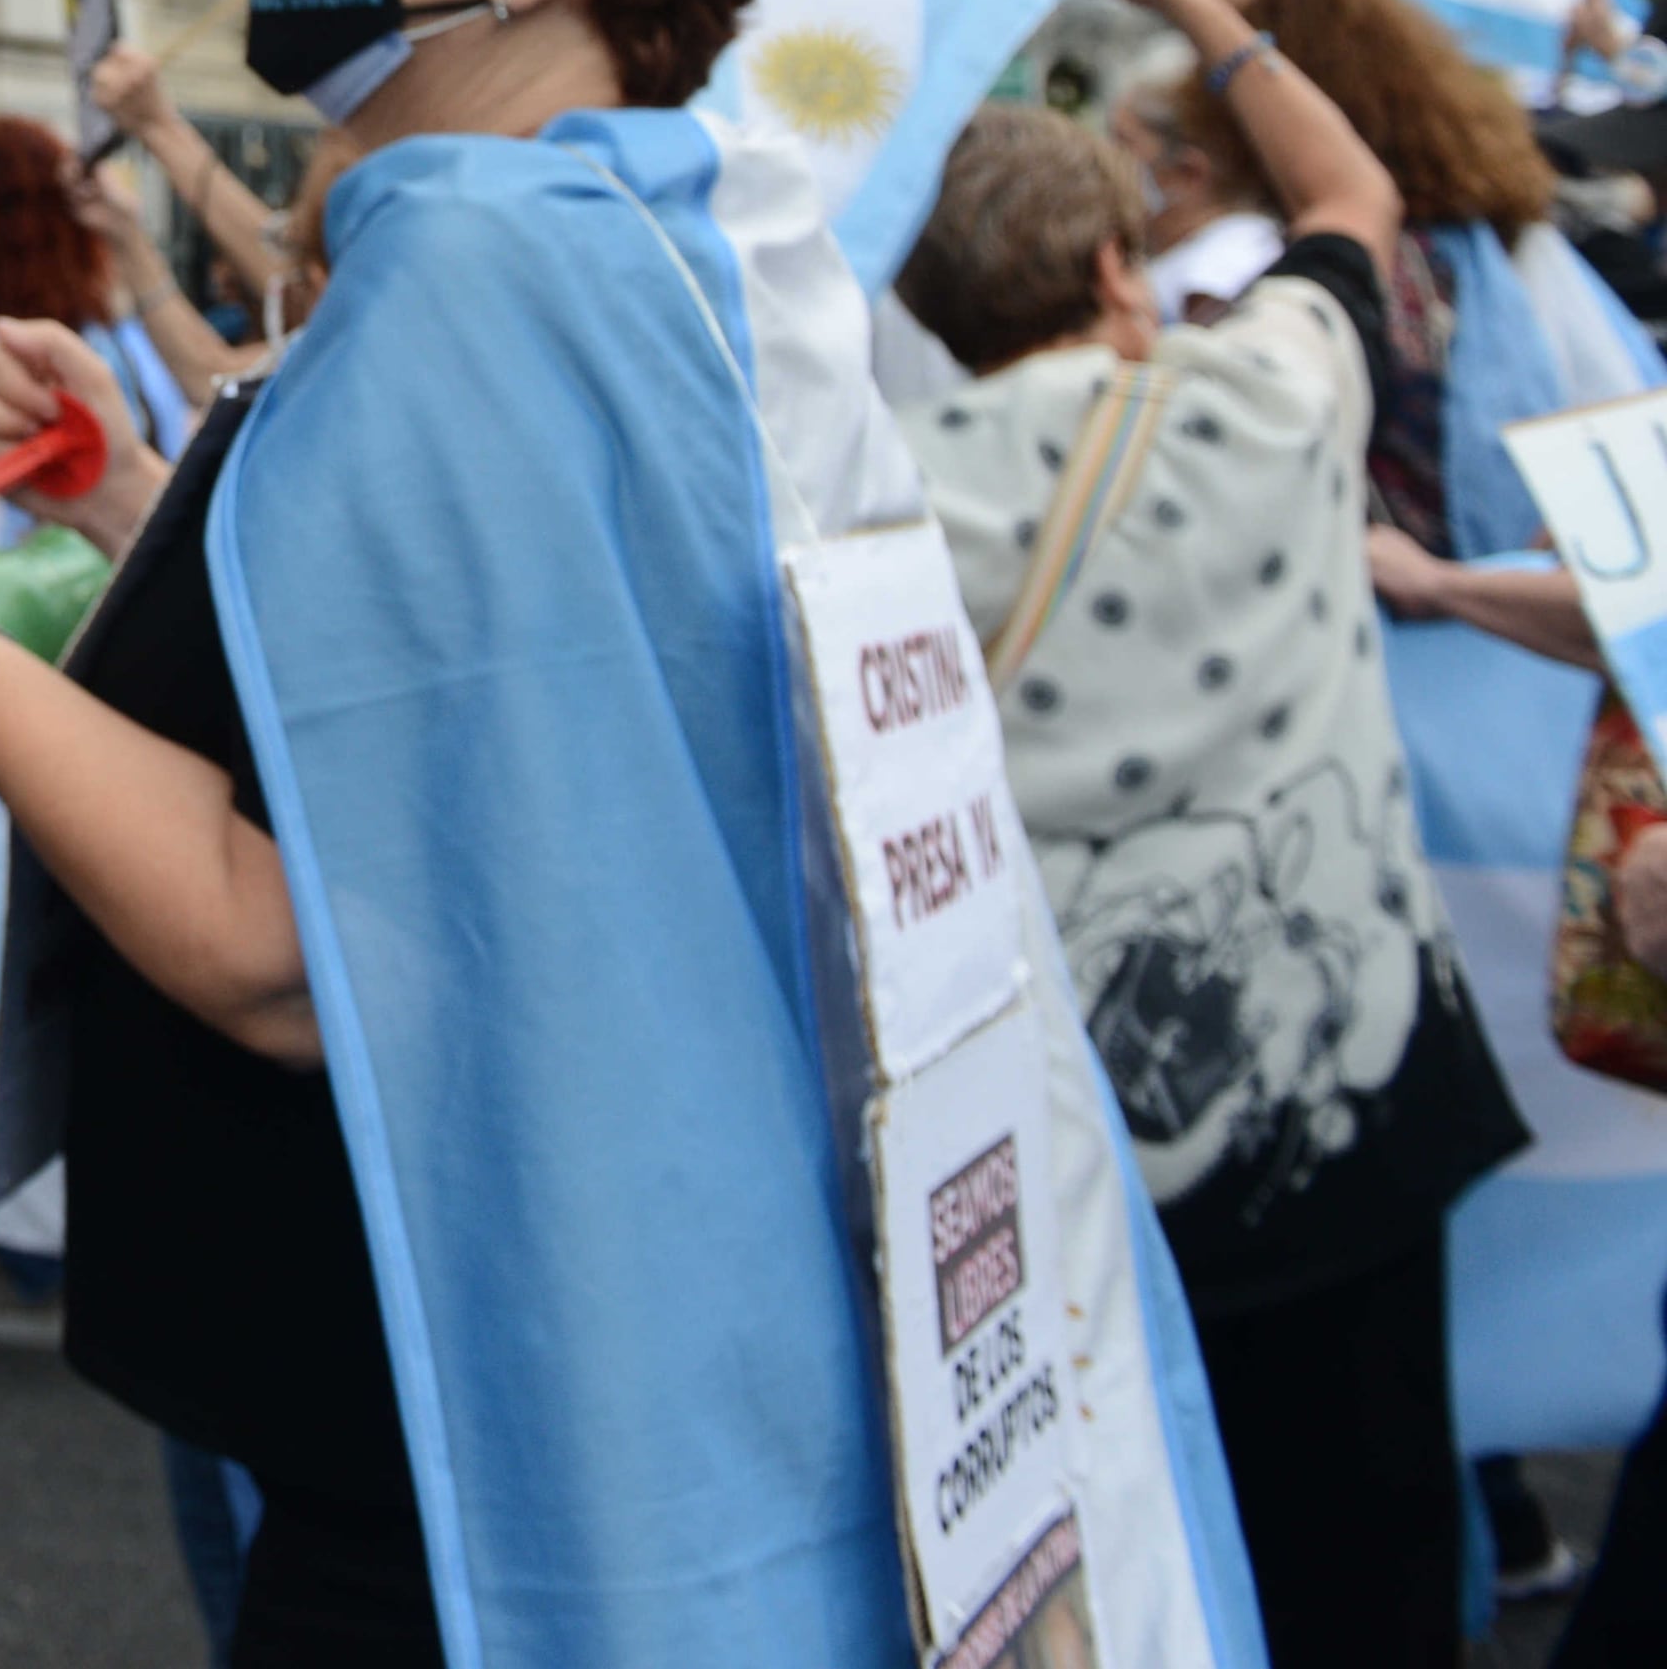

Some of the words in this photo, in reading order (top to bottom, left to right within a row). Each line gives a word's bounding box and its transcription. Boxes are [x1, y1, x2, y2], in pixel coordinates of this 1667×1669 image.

[857, 627, 970, 736] CRISTINA
[882, 810, 973, 932] PRESA
[968, 792, 1005, 882] YA
[932, 1138, 1017, 1265] SEAMOS
[940, 1227, 1021, 1343] LIBRES
[953, 1344, 982, 1423] DE
[983, 1305, 1026, 1389] LOS
[935, 1360, 1060, 1535] CORRUPTOS
